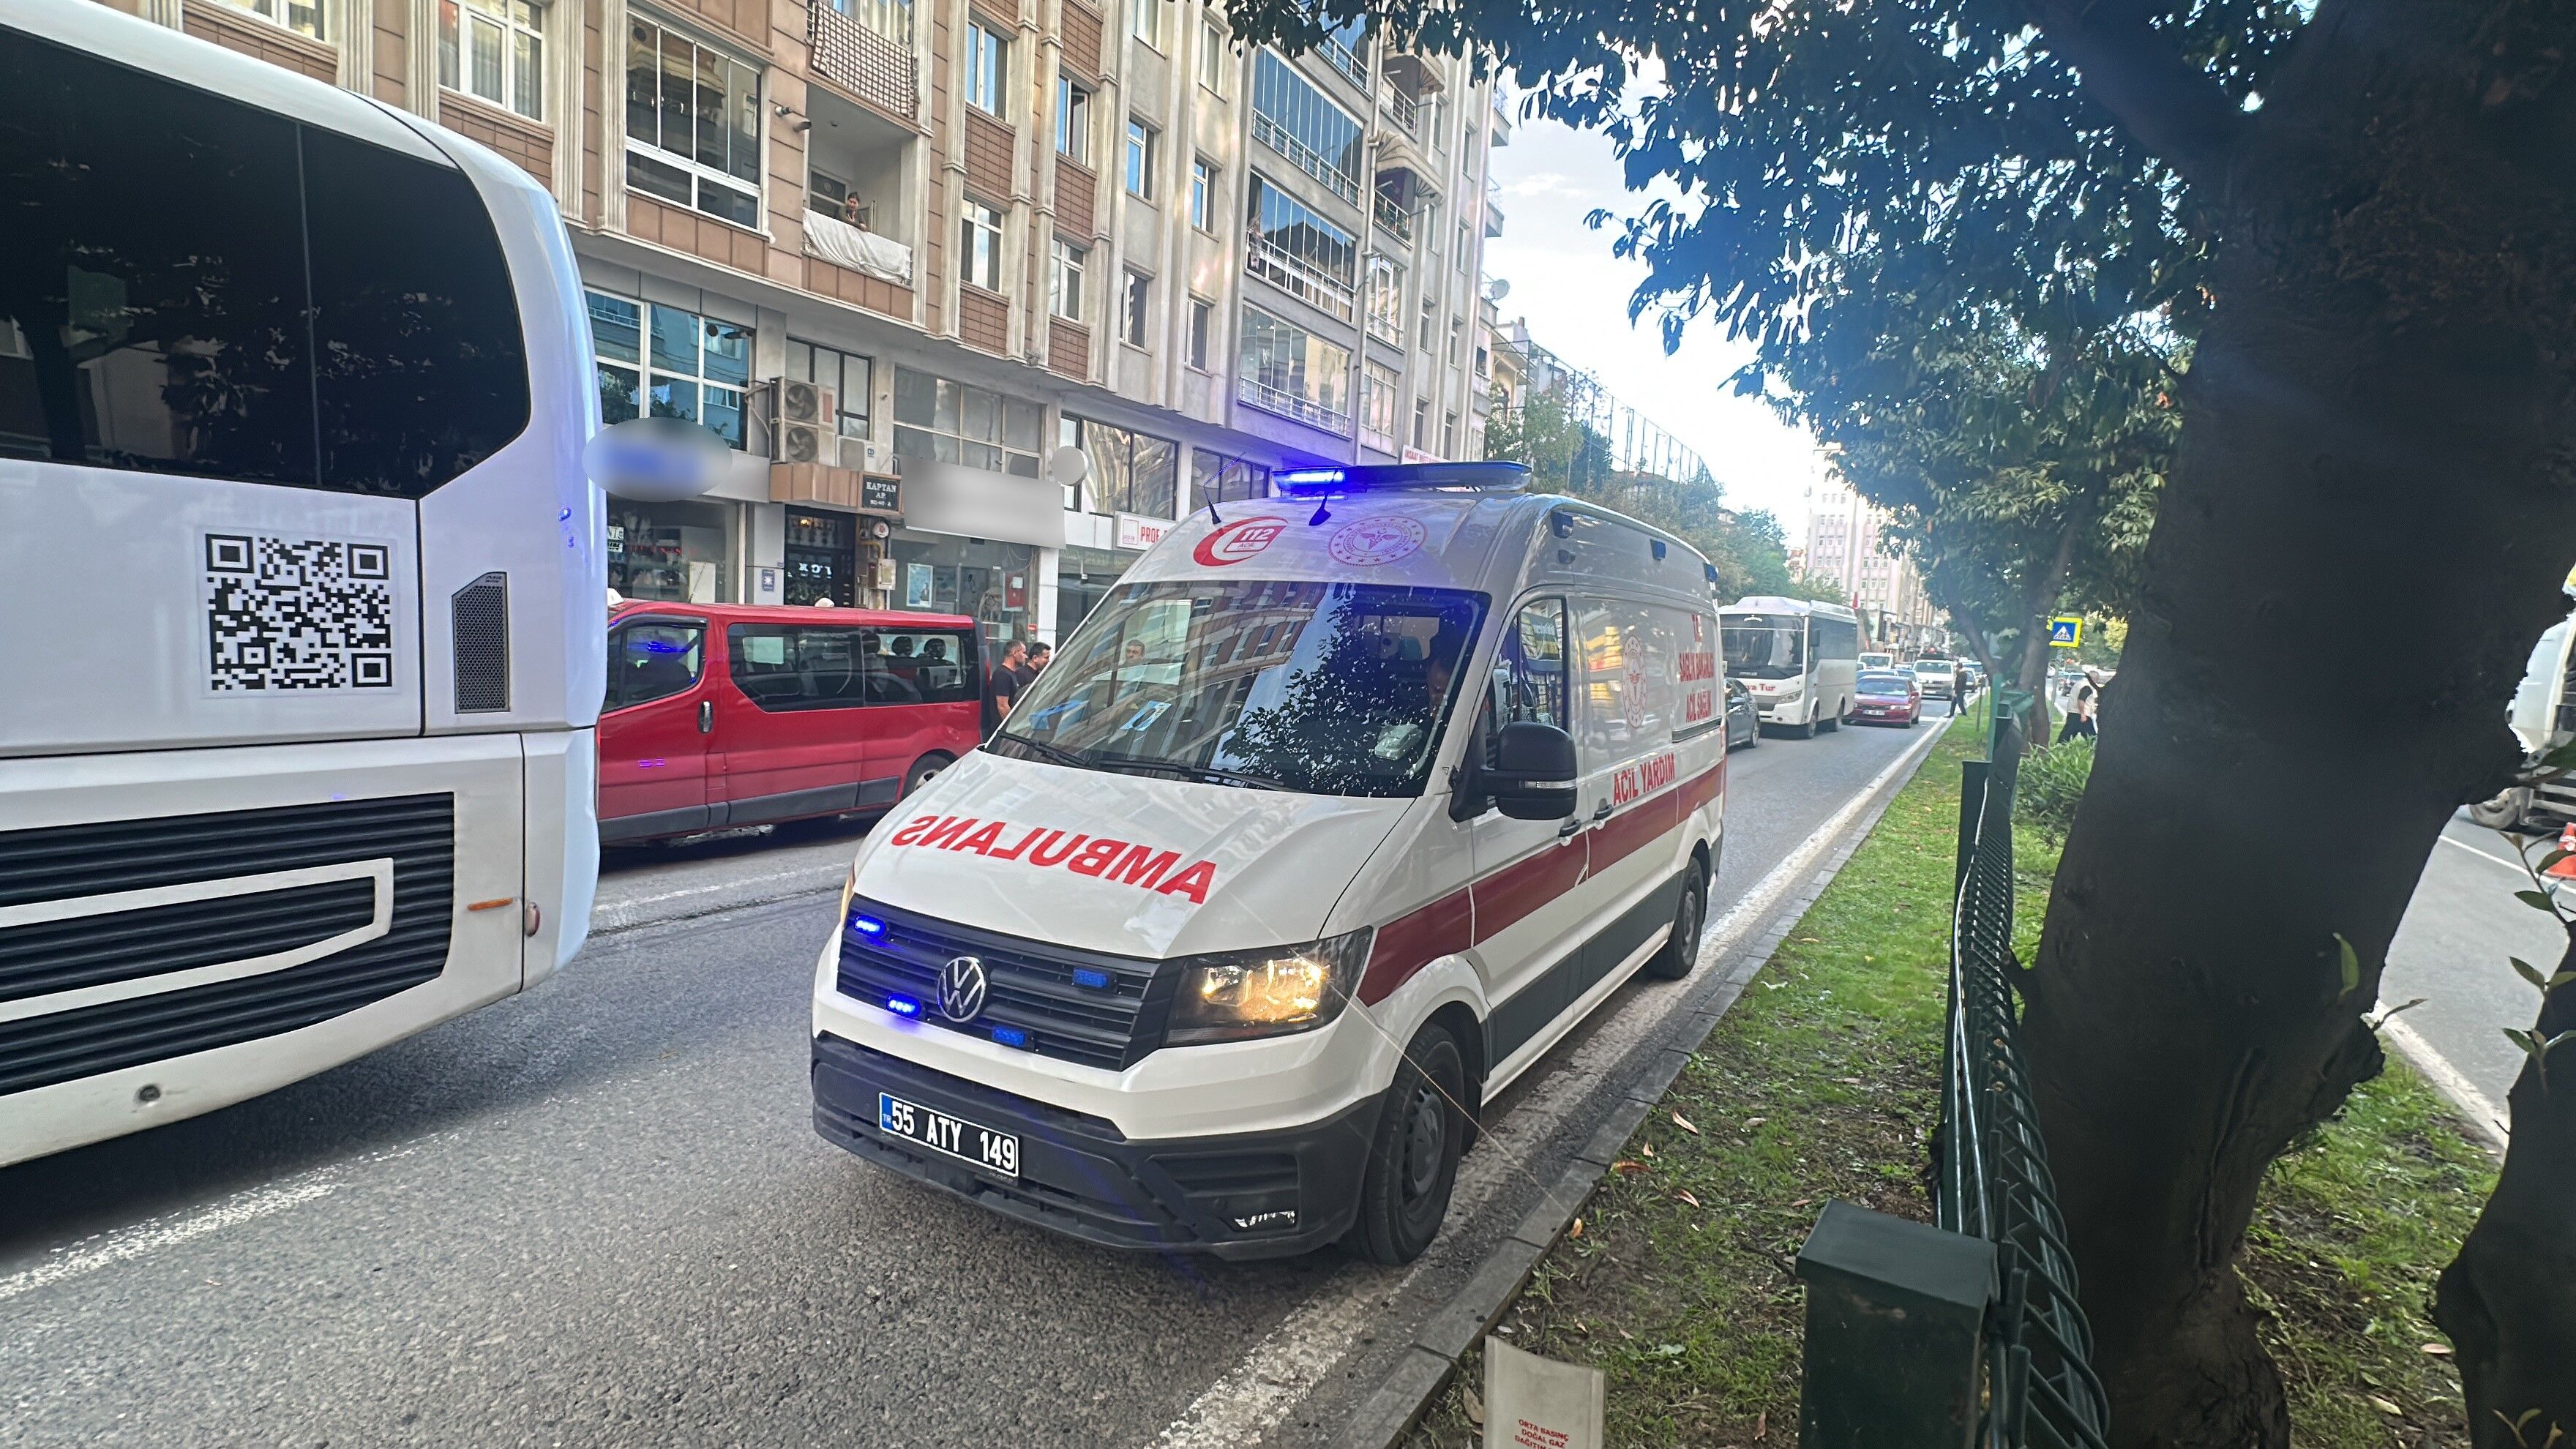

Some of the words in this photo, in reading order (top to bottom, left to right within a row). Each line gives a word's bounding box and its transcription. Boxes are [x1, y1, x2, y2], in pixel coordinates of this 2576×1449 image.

[866, 482, 896, 493] KAPTAN
[1240, 528, 1275, 542] 112
[1759, 684, 1775, 692] Tur
[1613, 767, 1639, 806] ACİL
[1639, 752, 1676, 793] YARDIM
[883, 1113, 891, 1123] TR
[892, 1101, 915, 1135] 55
[926, 1114, 962, 1153] ATY
[980, 1131, 1015, 1170] 149
[1519, 1419, 1538, 1431] ORTA
[1522, 1429, 1546, 1443] DOĞAL
[1549, 1439, 1565, 1448] GAZ
